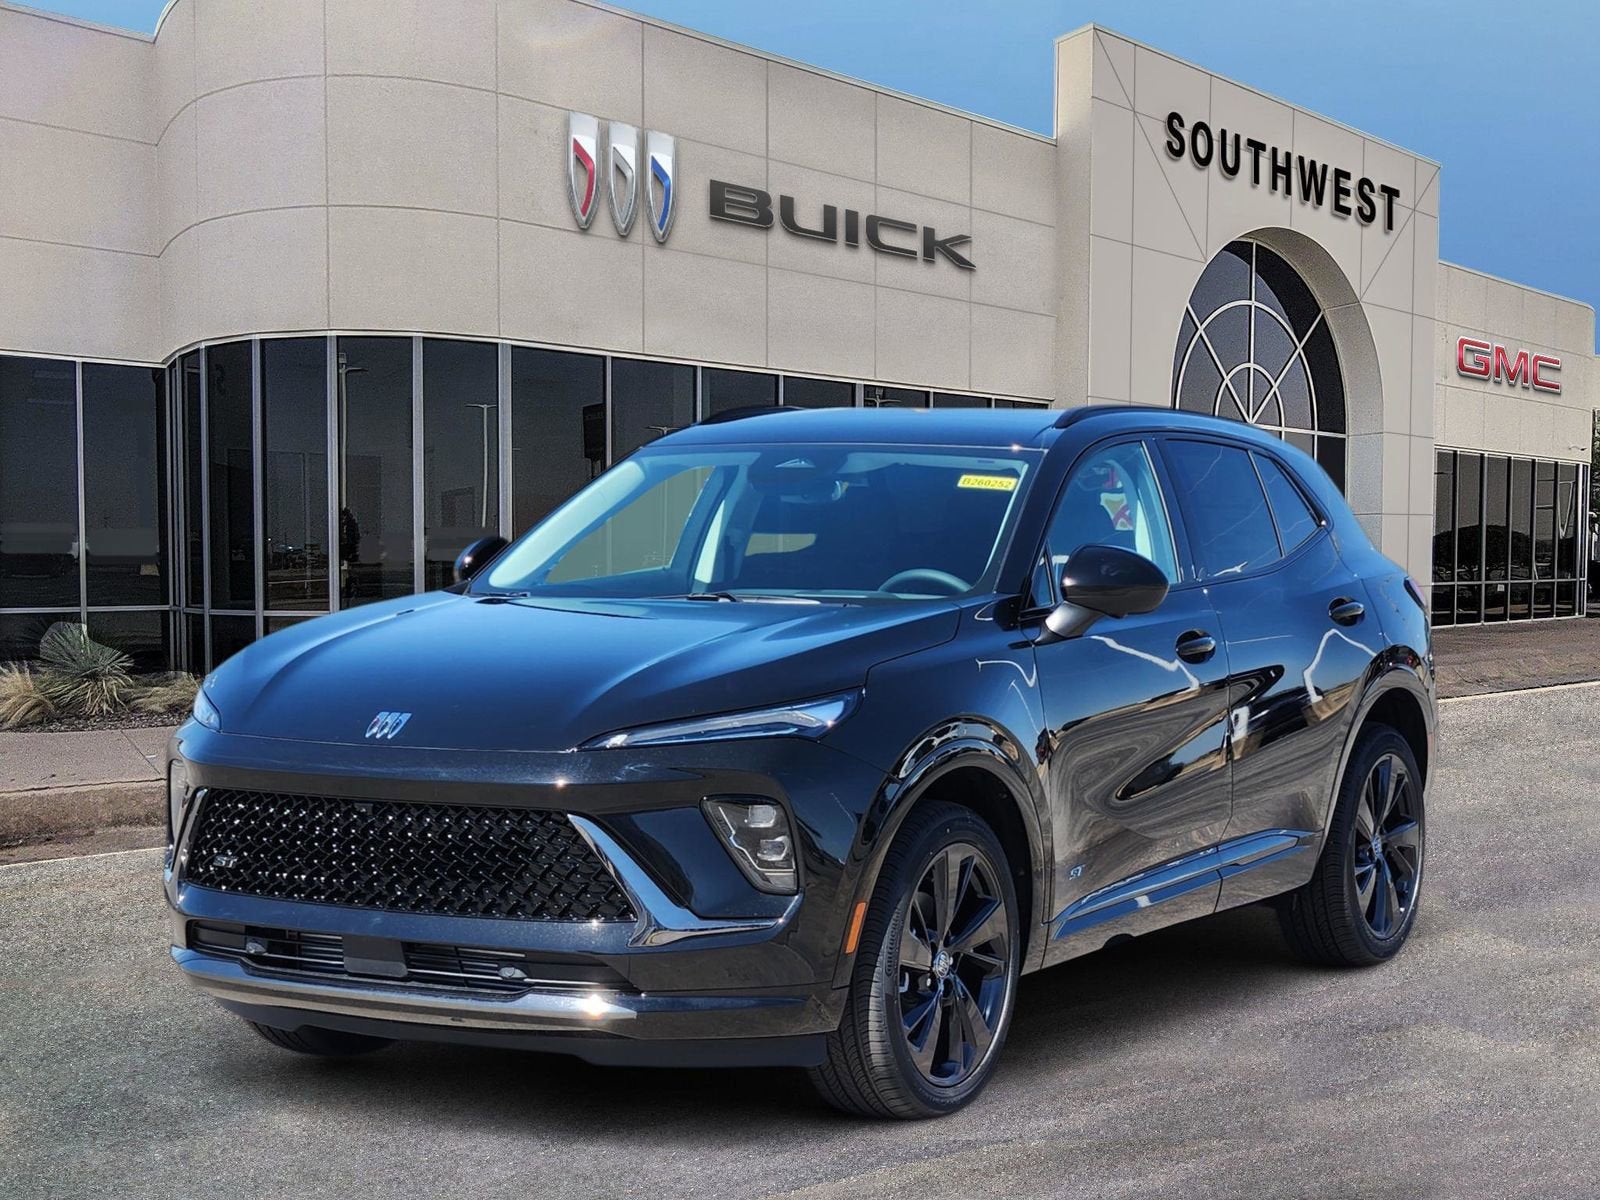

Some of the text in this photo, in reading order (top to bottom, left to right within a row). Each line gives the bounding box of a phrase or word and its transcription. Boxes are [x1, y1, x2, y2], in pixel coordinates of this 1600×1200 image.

[1166, 112, 1400, 231] SOUTHWEST
[709, 178, 977, 271] BUICK
[1457, 336, 1561, 395] GMC
